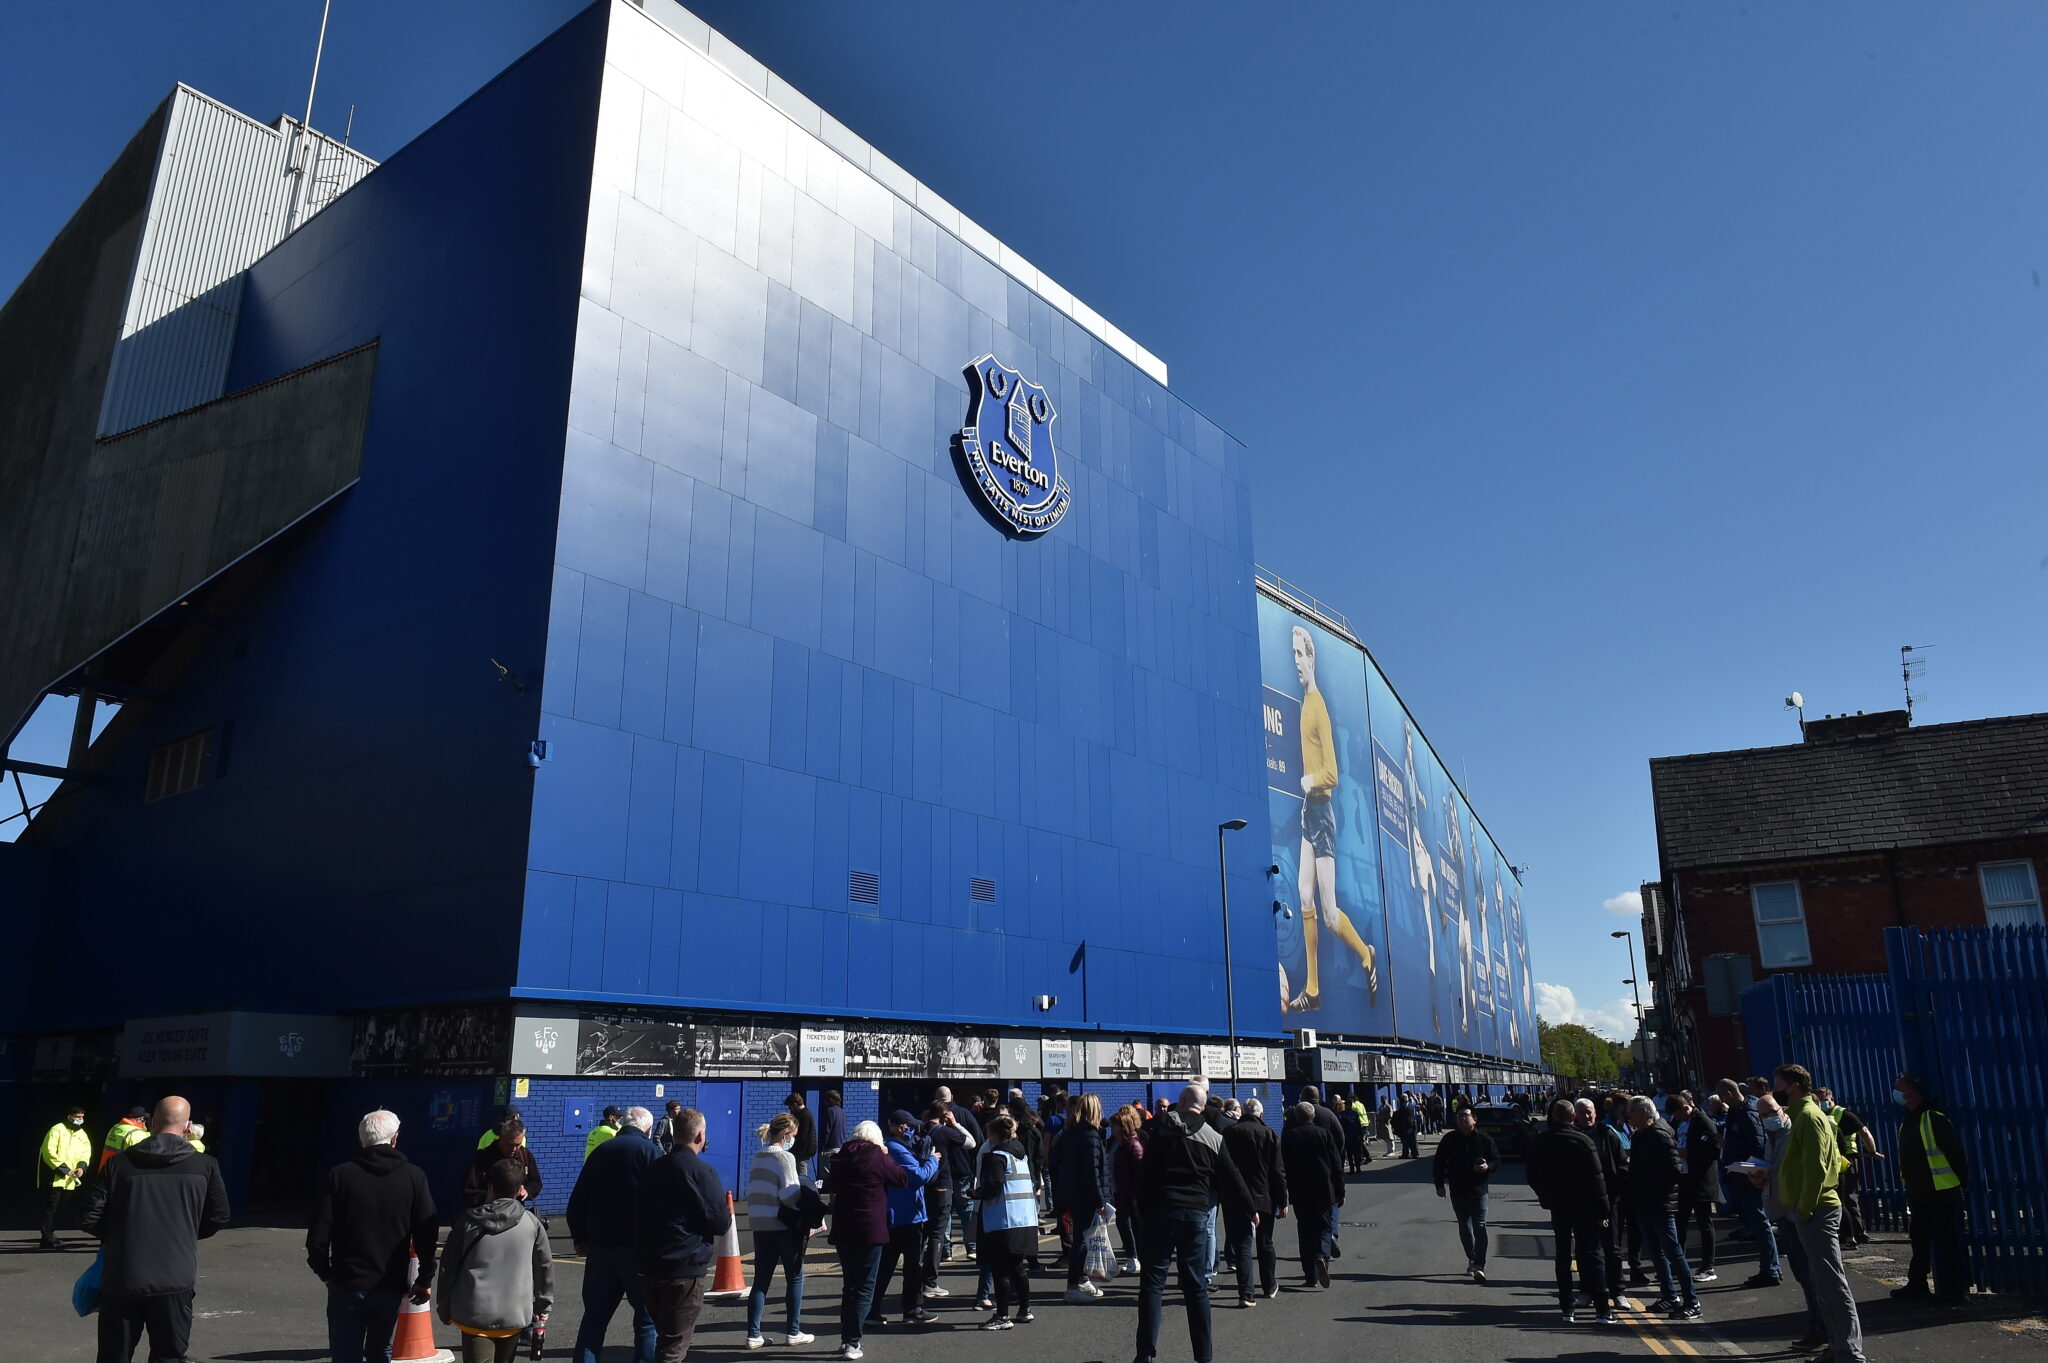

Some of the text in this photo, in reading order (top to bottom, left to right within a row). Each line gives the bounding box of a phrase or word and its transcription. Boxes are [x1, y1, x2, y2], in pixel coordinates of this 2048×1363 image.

[972, 451, 1068, 526] NIL SATIS NISI OPTIMUM
[992, 440, 1049, 489] Everton
[1012, 478, 1030, 496] 1878
